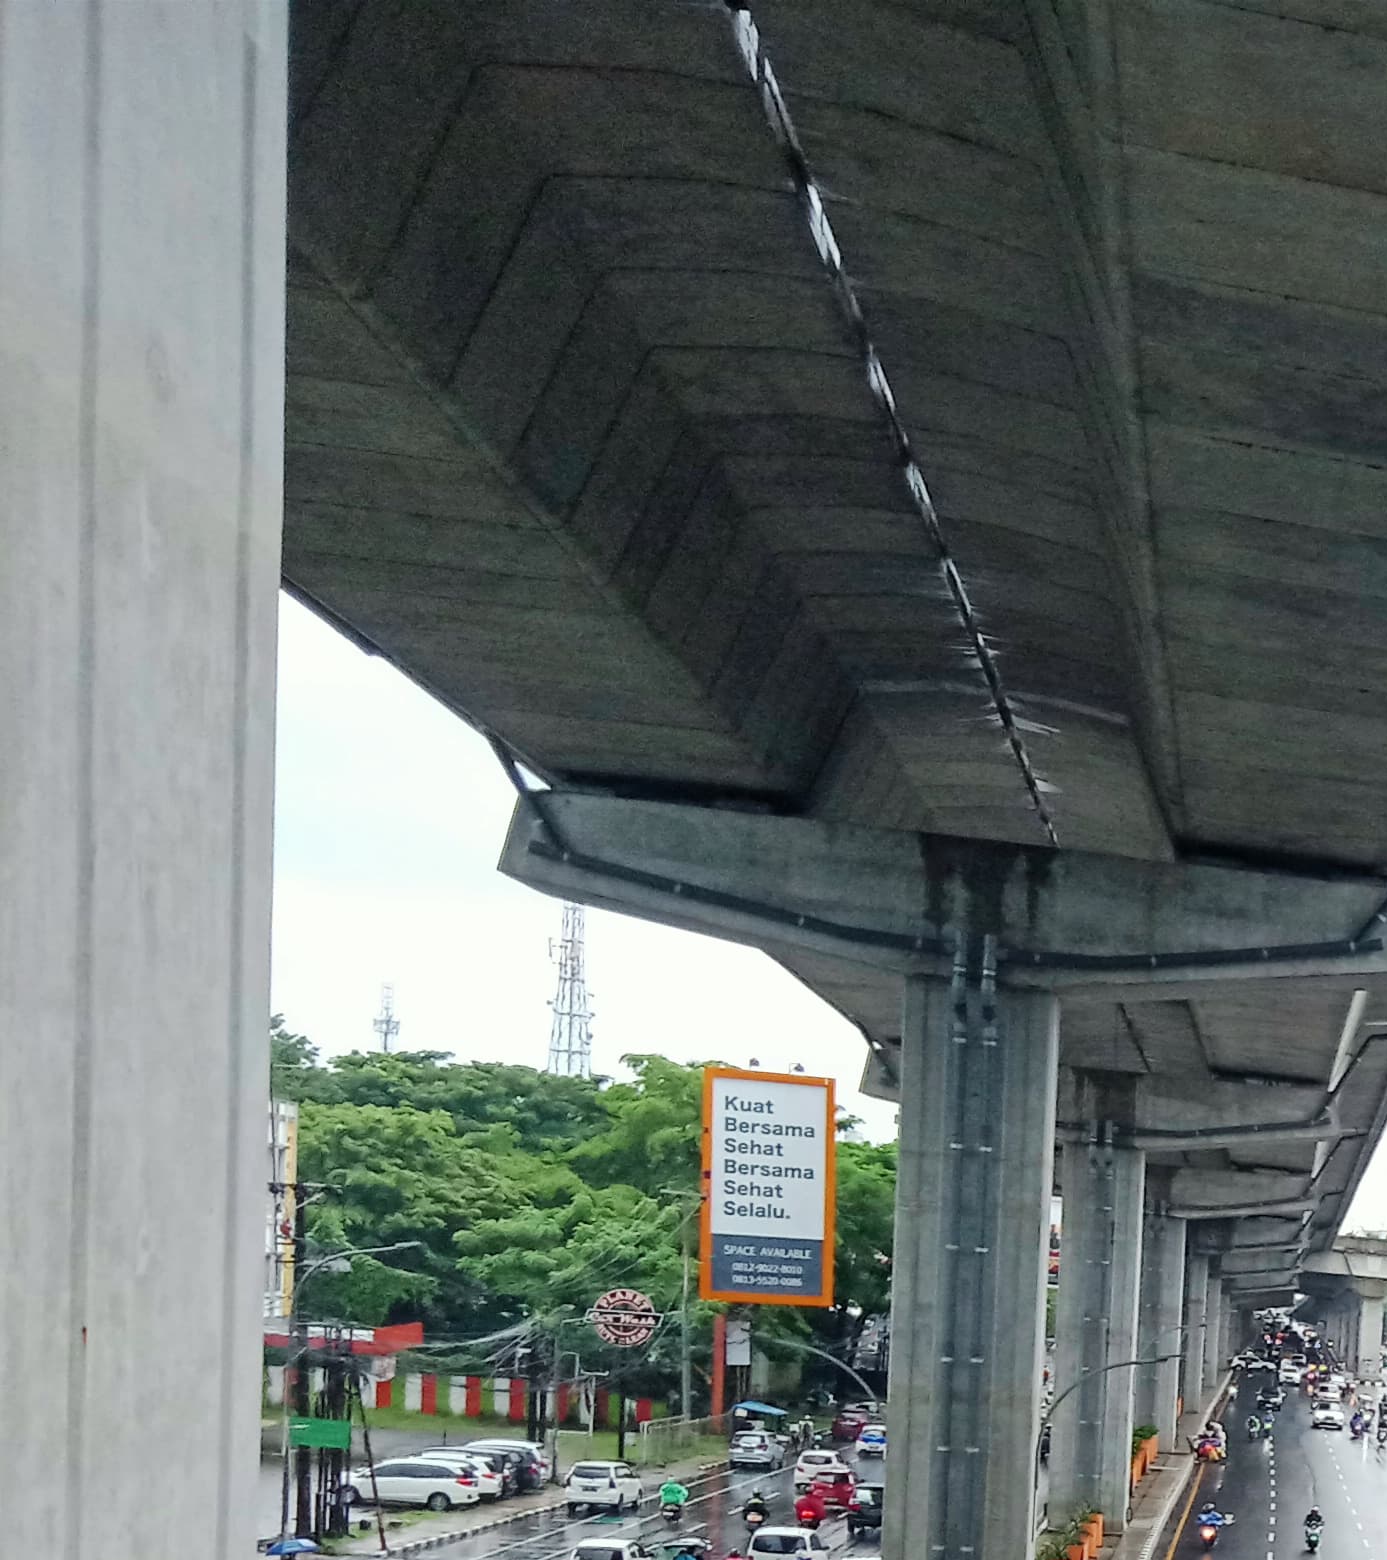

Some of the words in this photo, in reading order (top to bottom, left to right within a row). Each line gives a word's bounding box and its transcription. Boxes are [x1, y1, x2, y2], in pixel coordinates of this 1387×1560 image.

[724, 1096, 774, 1114] Kuat
[724, 1117, 815, 1138] Bersama
[723, 1138, 784, 1157] Sehat
[723, 1159, 815, 1179] Bersama
[723, 1180, 784, 1199] Sehat
[723, 1201, 791, 1219] Selalu.
[723, 1244, 756, 1257] SPACE
[759, 1247, 812, 1260] AVAILABLE
